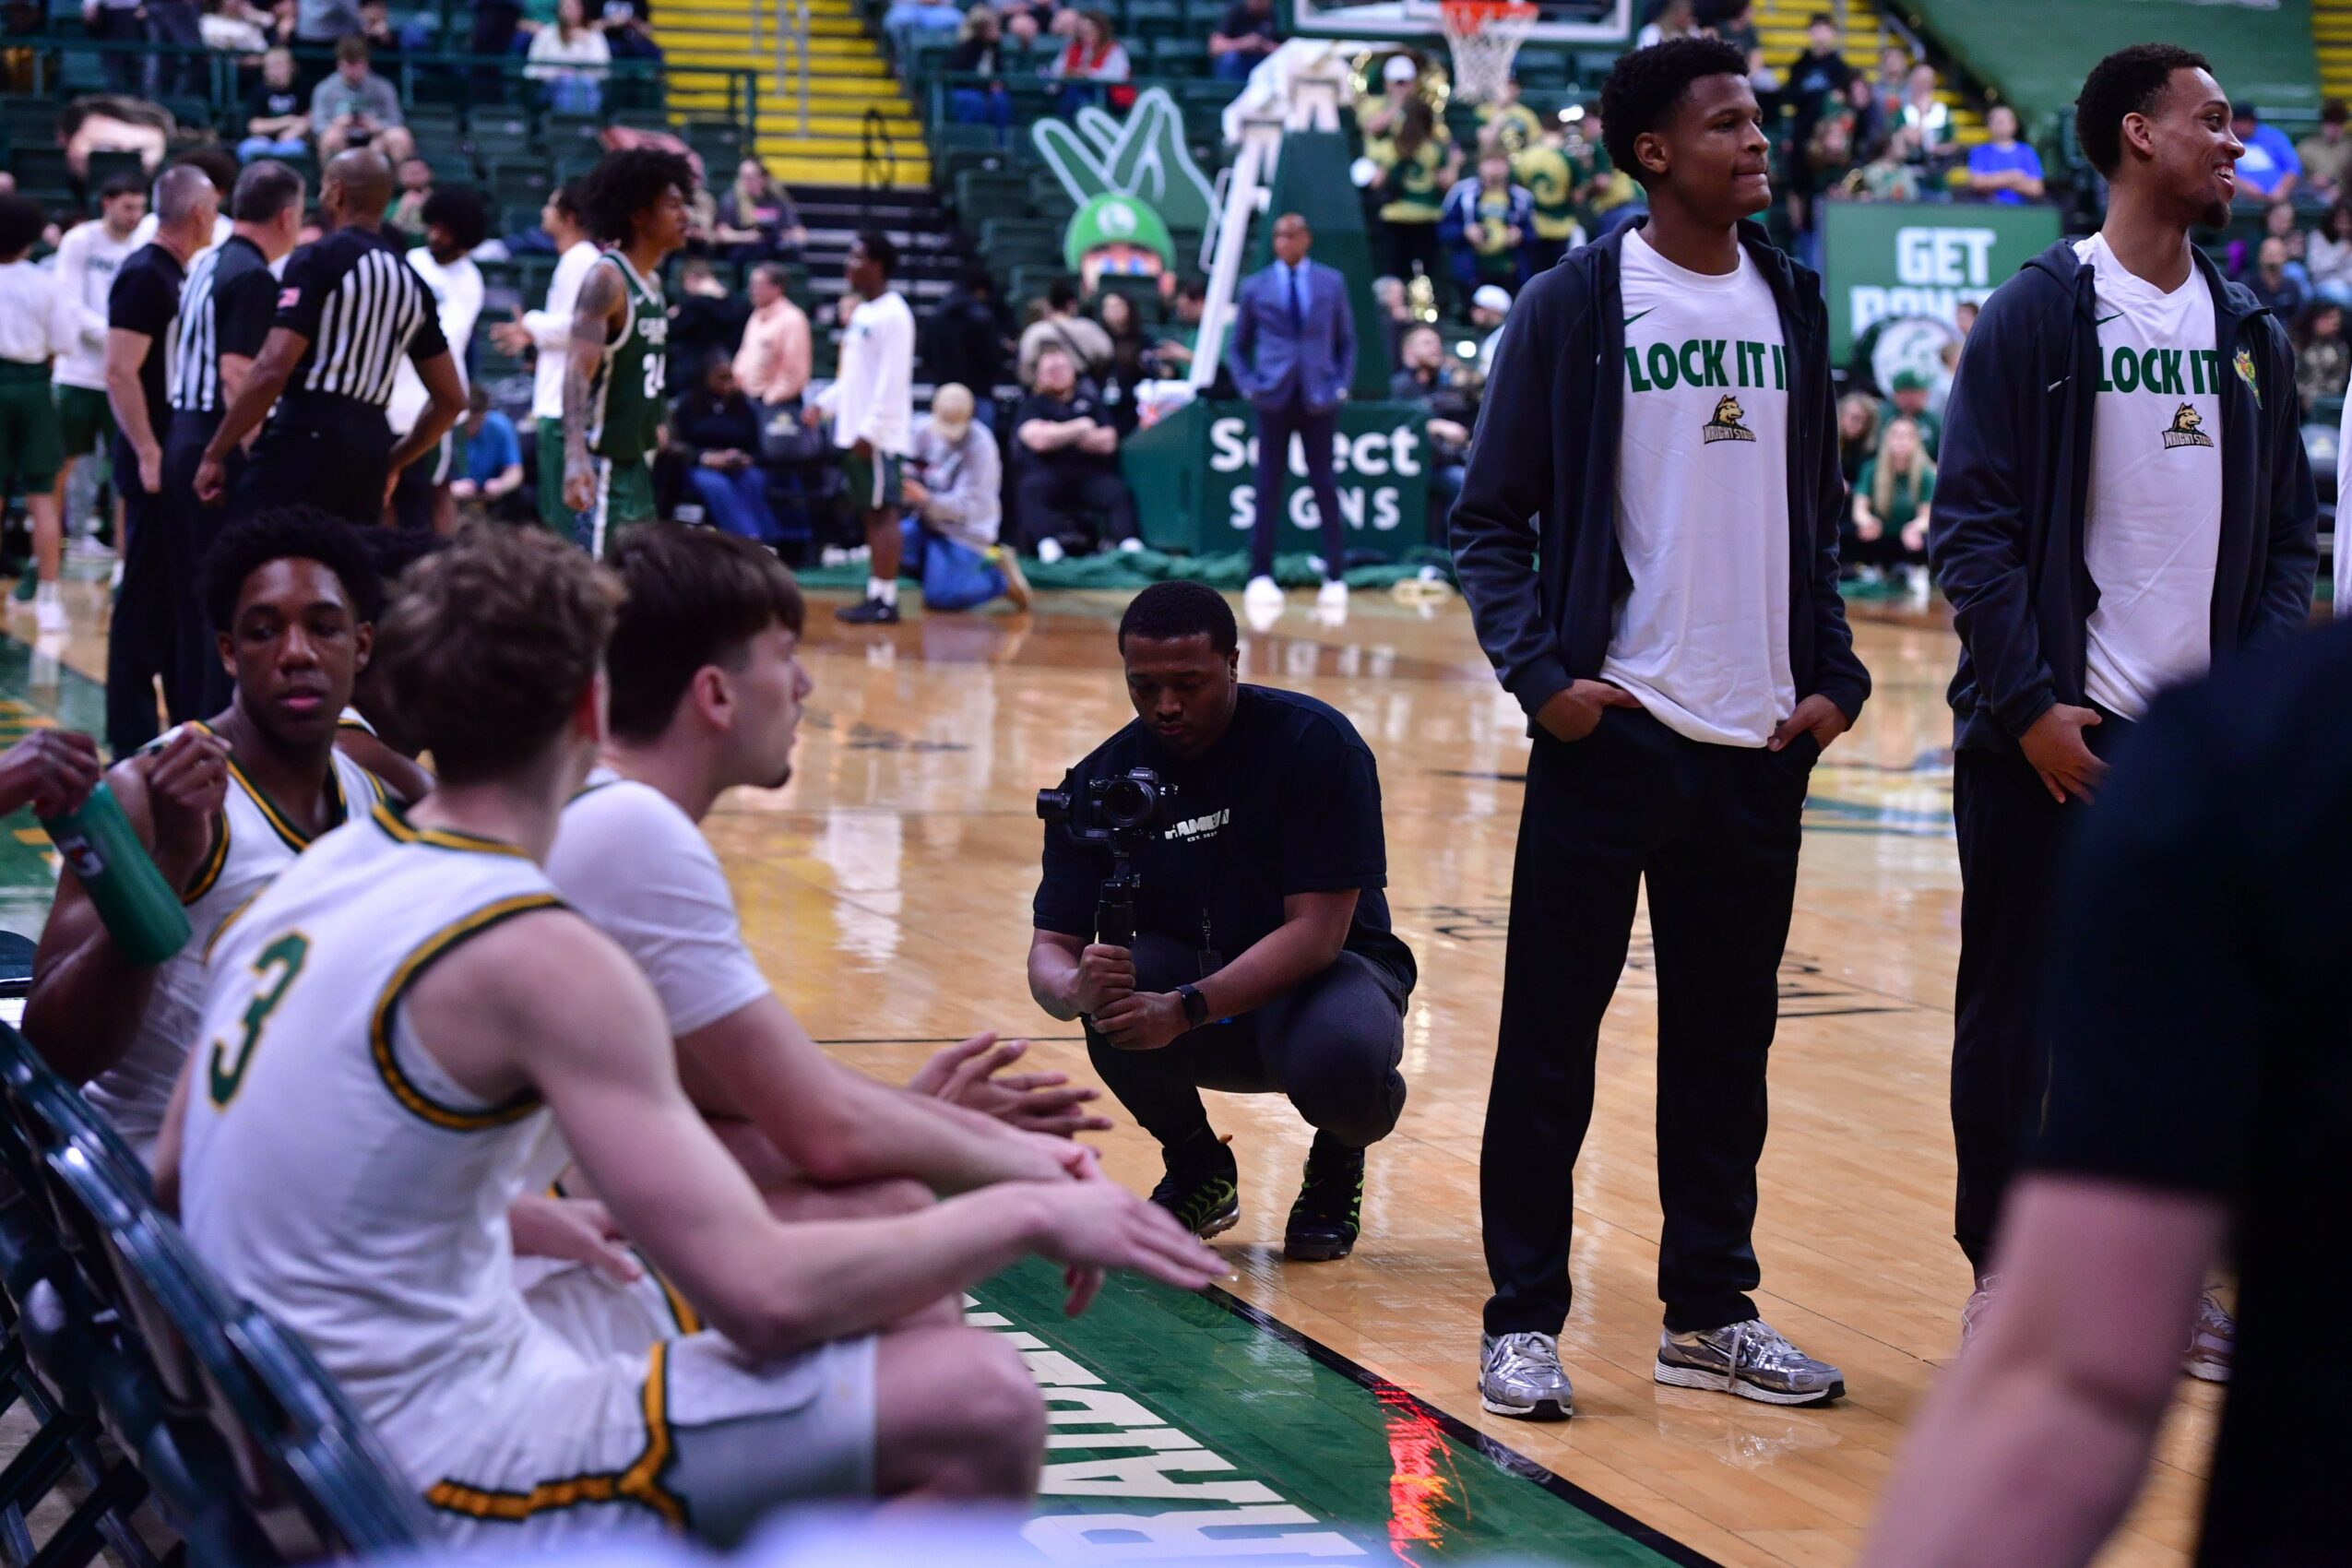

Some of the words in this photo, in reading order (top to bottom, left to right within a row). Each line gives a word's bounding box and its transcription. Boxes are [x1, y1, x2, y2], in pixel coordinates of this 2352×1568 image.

[1895, 226, 1998, 286] GET
[1625, 339, 1729, 392] LOCK
[1736, 340, 1766, 387] IT
[1772, 344, 1788, 391] I
[2097, 346, 2186, 395] LOCK
[2189, 350, 2220, 395] IT
[1229, 484, 1401, 531] SGNS
[208, 931, 312, 1113] 3
